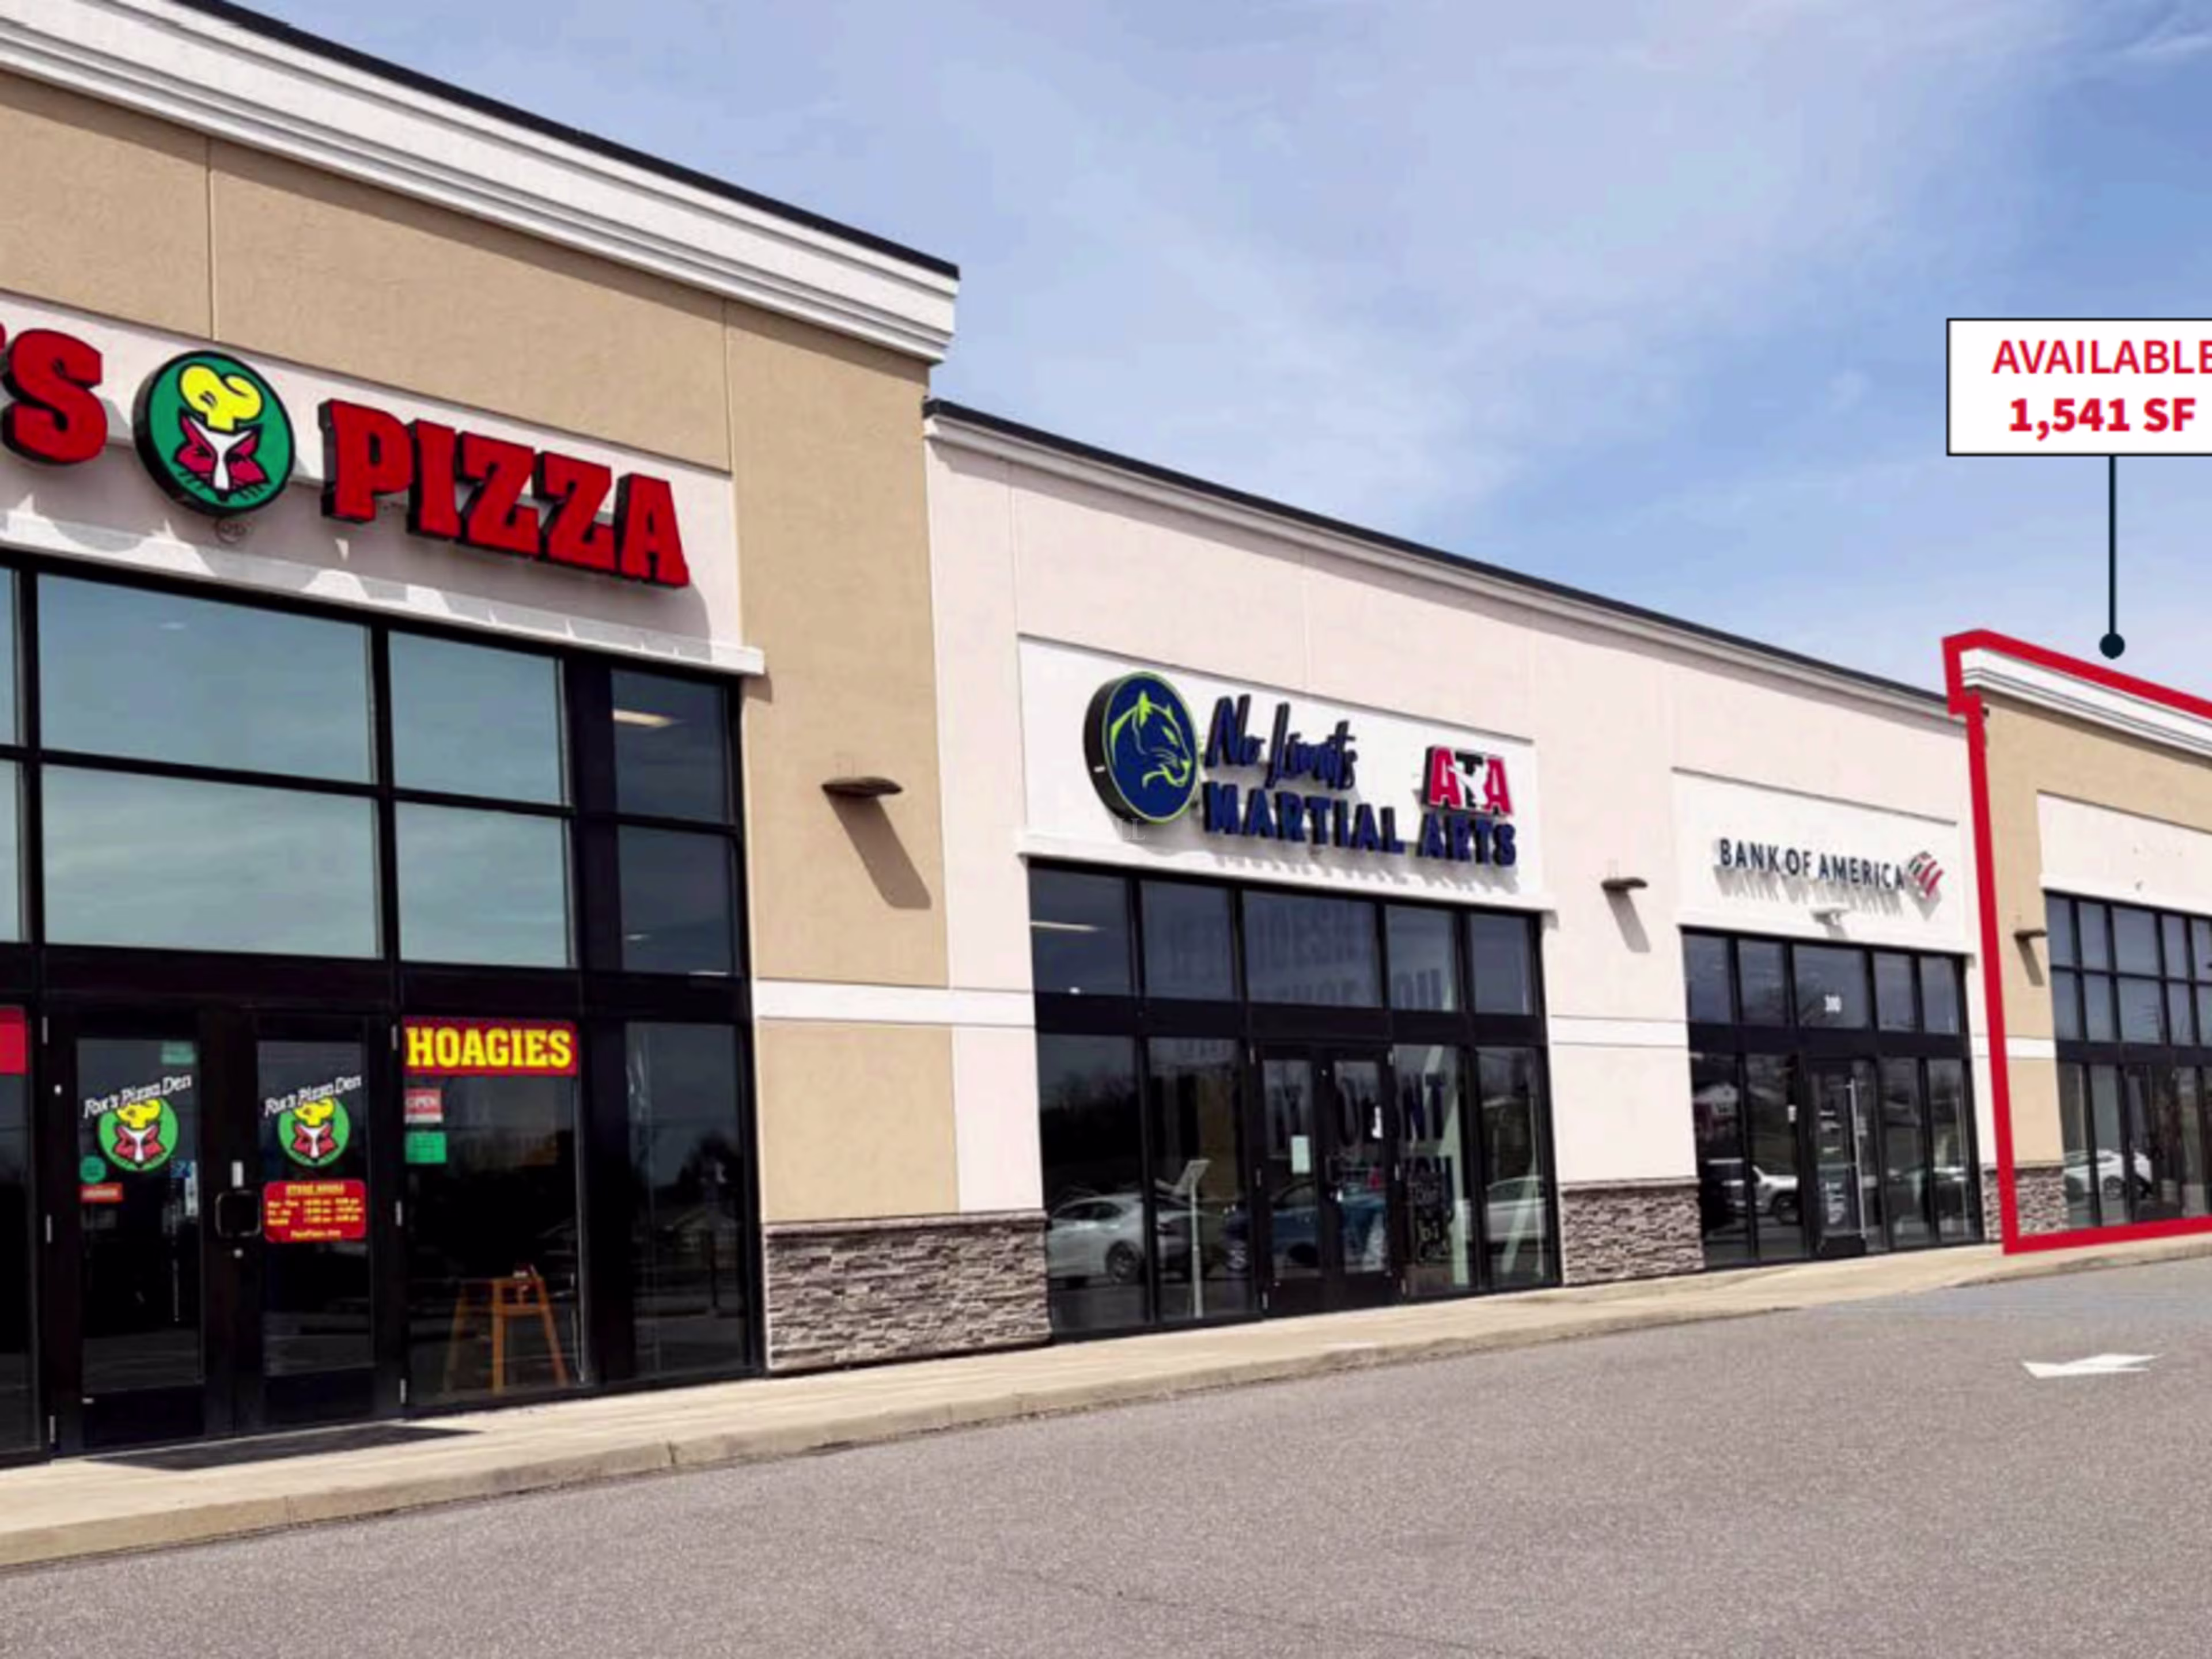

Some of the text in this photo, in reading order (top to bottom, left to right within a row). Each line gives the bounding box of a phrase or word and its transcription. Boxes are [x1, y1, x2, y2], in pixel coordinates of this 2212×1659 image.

[0, 324, 690, 588] S PIZZA
[1205, 694, 1266, 767] No
[1422, 745, 1513, 817] ATA
[1202, 781, 1517, 867] MARTIAL ARTS
[1719, 838, 1904, 890] BANK OF AMERICA
[405, 1026, 572, 1067] HOAGIES
[119, 1081, 161, 1107] Pizza
[161, 1074, 192, 1094] Den
[334, 1074, 362, 1093] Den
